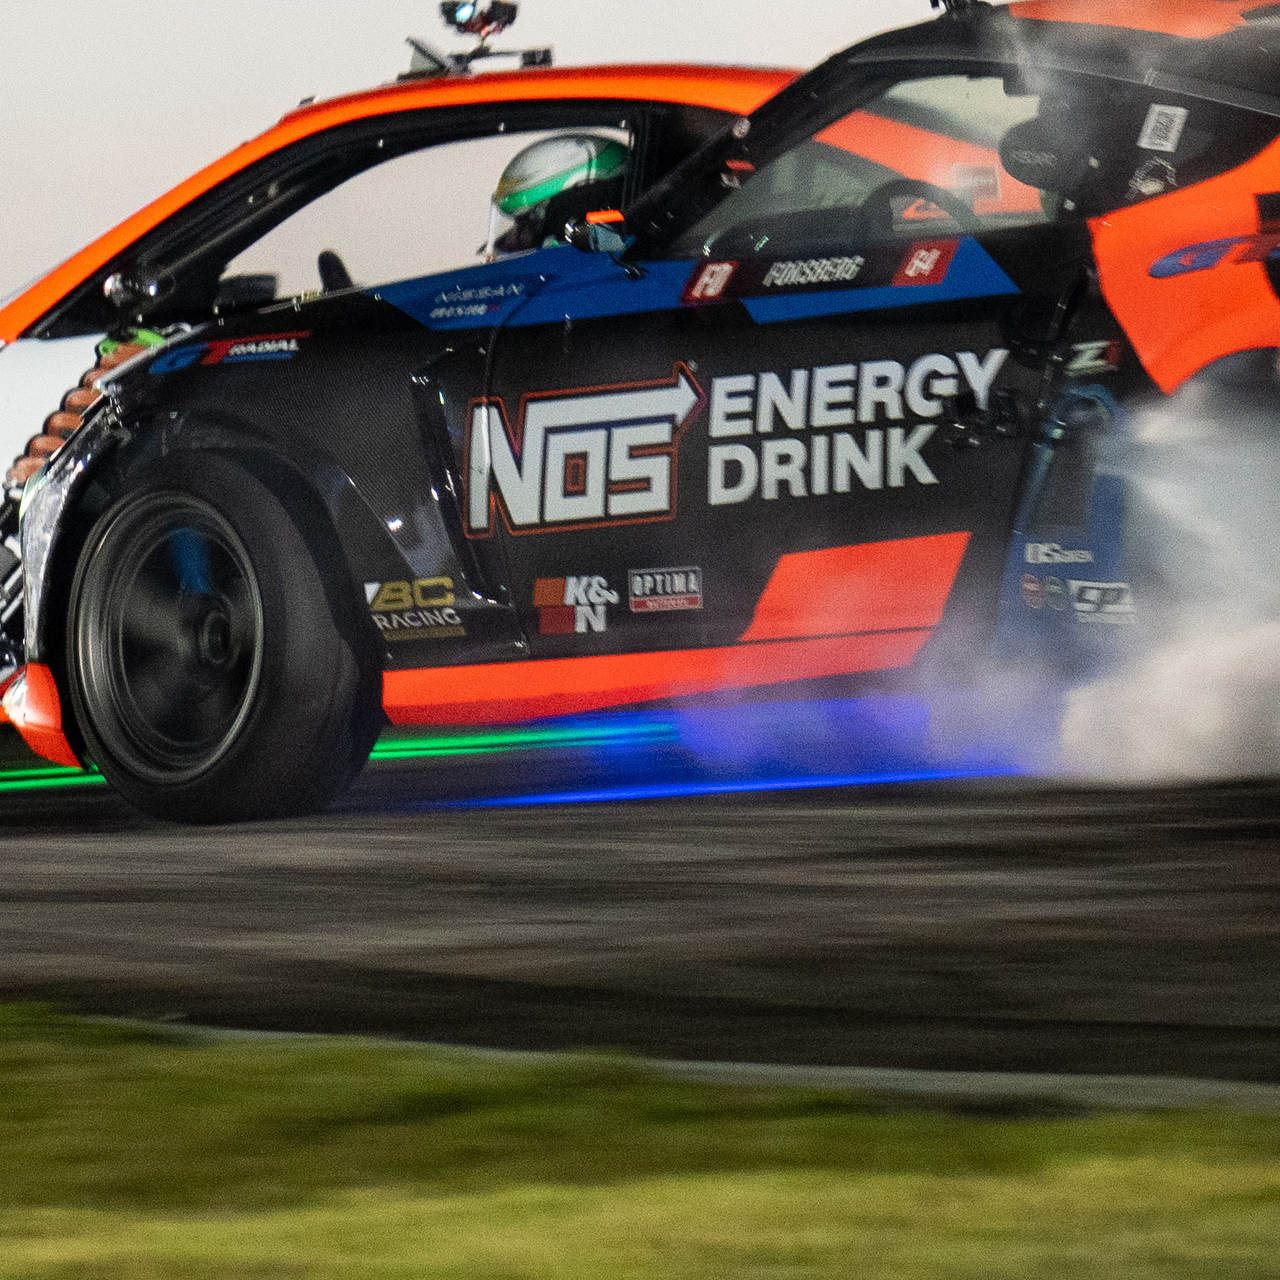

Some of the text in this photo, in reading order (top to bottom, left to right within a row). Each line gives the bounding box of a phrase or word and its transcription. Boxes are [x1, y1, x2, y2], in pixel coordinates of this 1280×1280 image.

[709, 348, 1010, 438] ENERGY
[464, 361, 704, 539] NOS
[707, 423, 940, 506] DRINK
[370, 577, 455, 612] BC
[631, 572, 700, 596] OPTIMA
[371, 607, 462, 630] RACING
